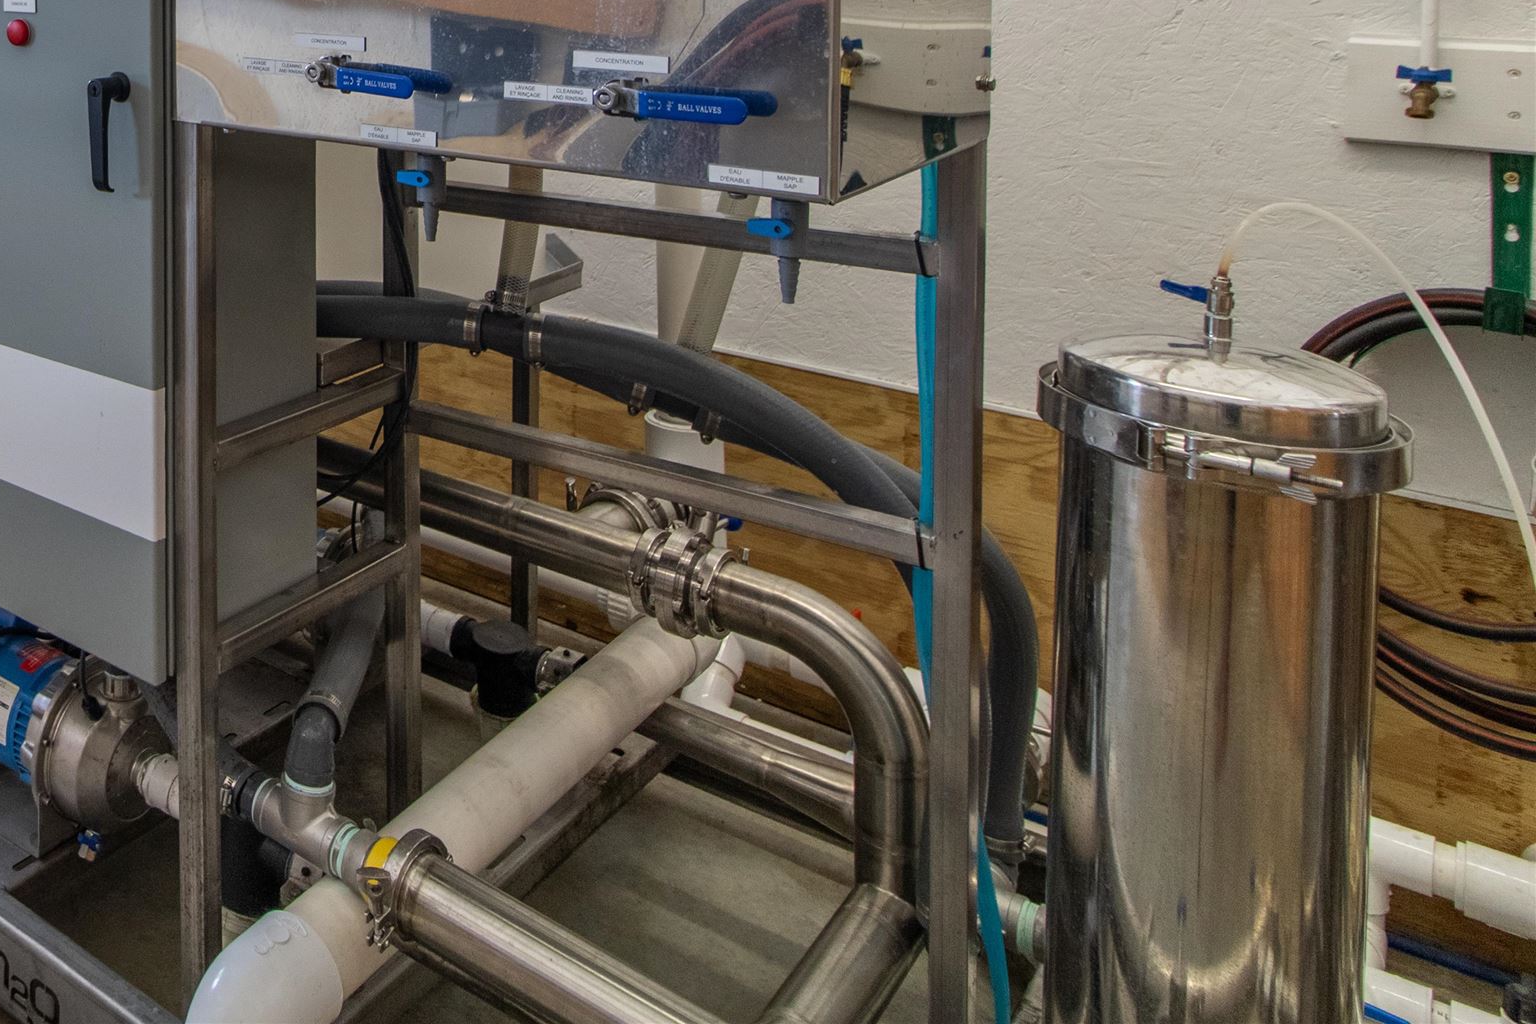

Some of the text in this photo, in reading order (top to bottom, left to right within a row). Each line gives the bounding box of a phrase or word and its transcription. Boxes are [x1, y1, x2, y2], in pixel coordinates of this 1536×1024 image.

[311, 38, 347, 46] CONCENTRATION
[595, 57, 644, 66] CONCENTRATION
[364, 79, 378, 87] BALL
[378, 81, 397, 90] VALVES
[514, 84, 536, 92] LAVAGE
[555, 88, 584, 96] CLEANING
[565, 95, 588, 103] RINSING
[677, 103, 694, 112] BALL
[694, 105, 721, 114] VALVES
[777, 175, 803, 183] MAPPLE
